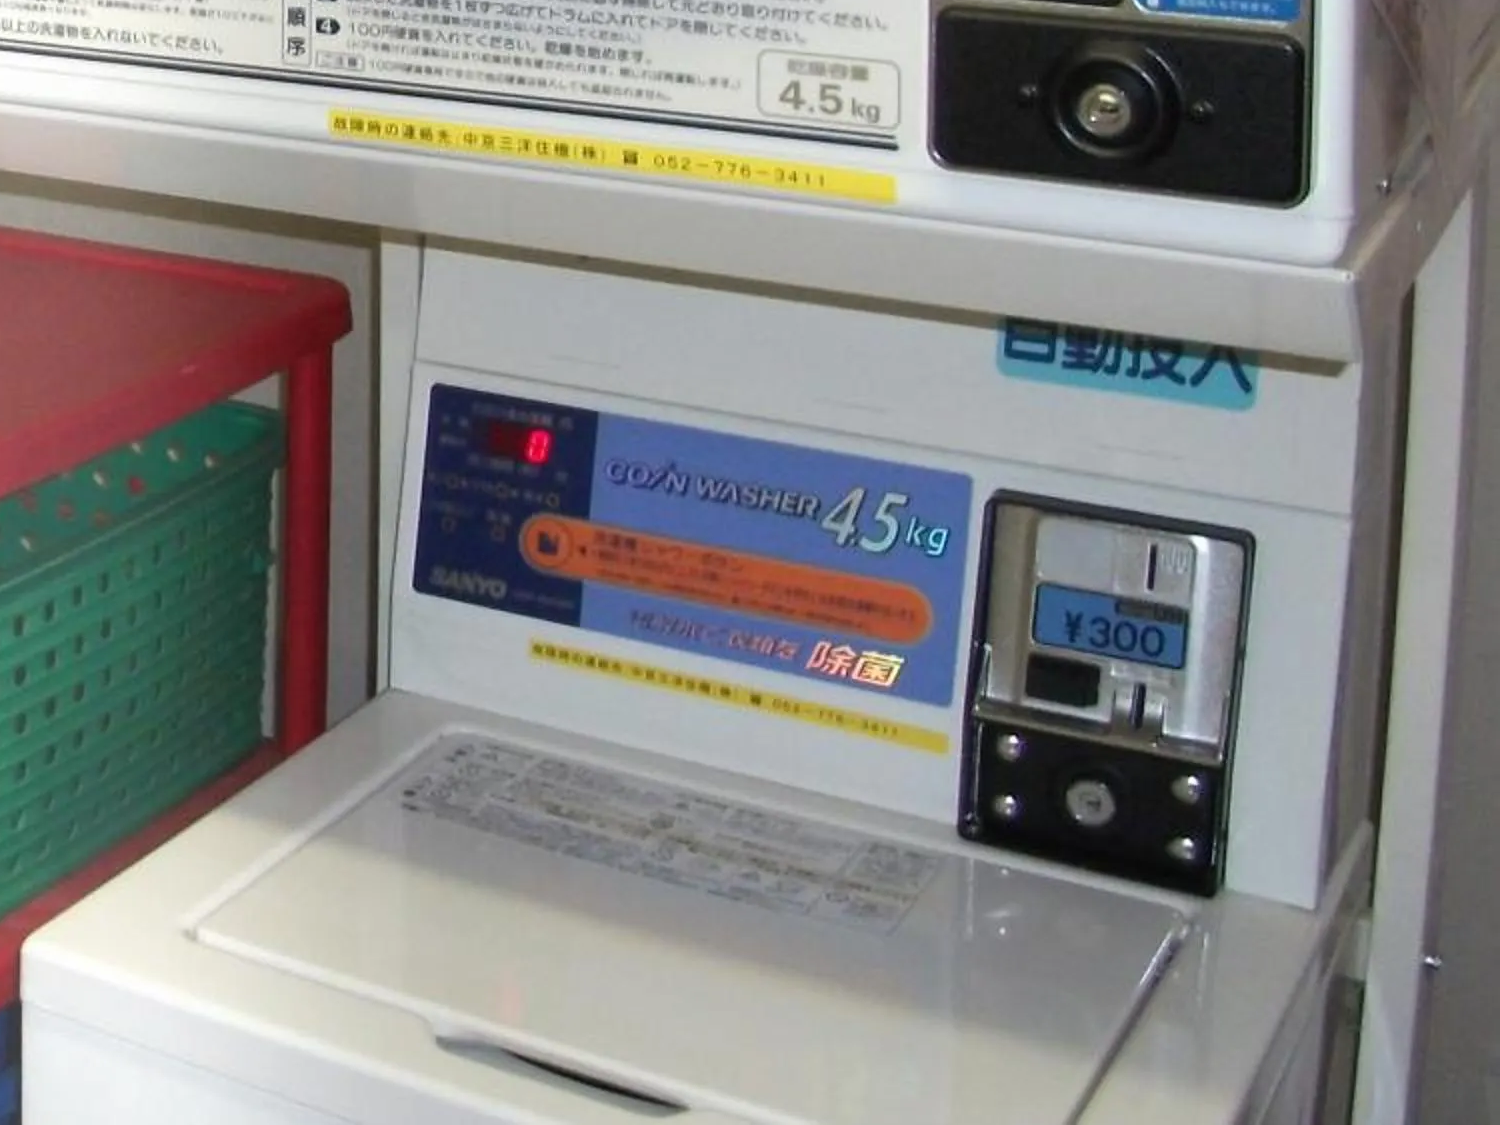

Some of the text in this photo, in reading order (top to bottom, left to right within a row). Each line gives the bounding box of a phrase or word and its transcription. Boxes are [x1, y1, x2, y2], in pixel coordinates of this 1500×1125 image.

[522, 428, 553, 465] 0
[696, 476, 821, 518] WASHER
[429, 567, 508, 600] SANYO
[1063, 608, 1166, 659] ¥300
[805, 640, 905, 689] 除菌
